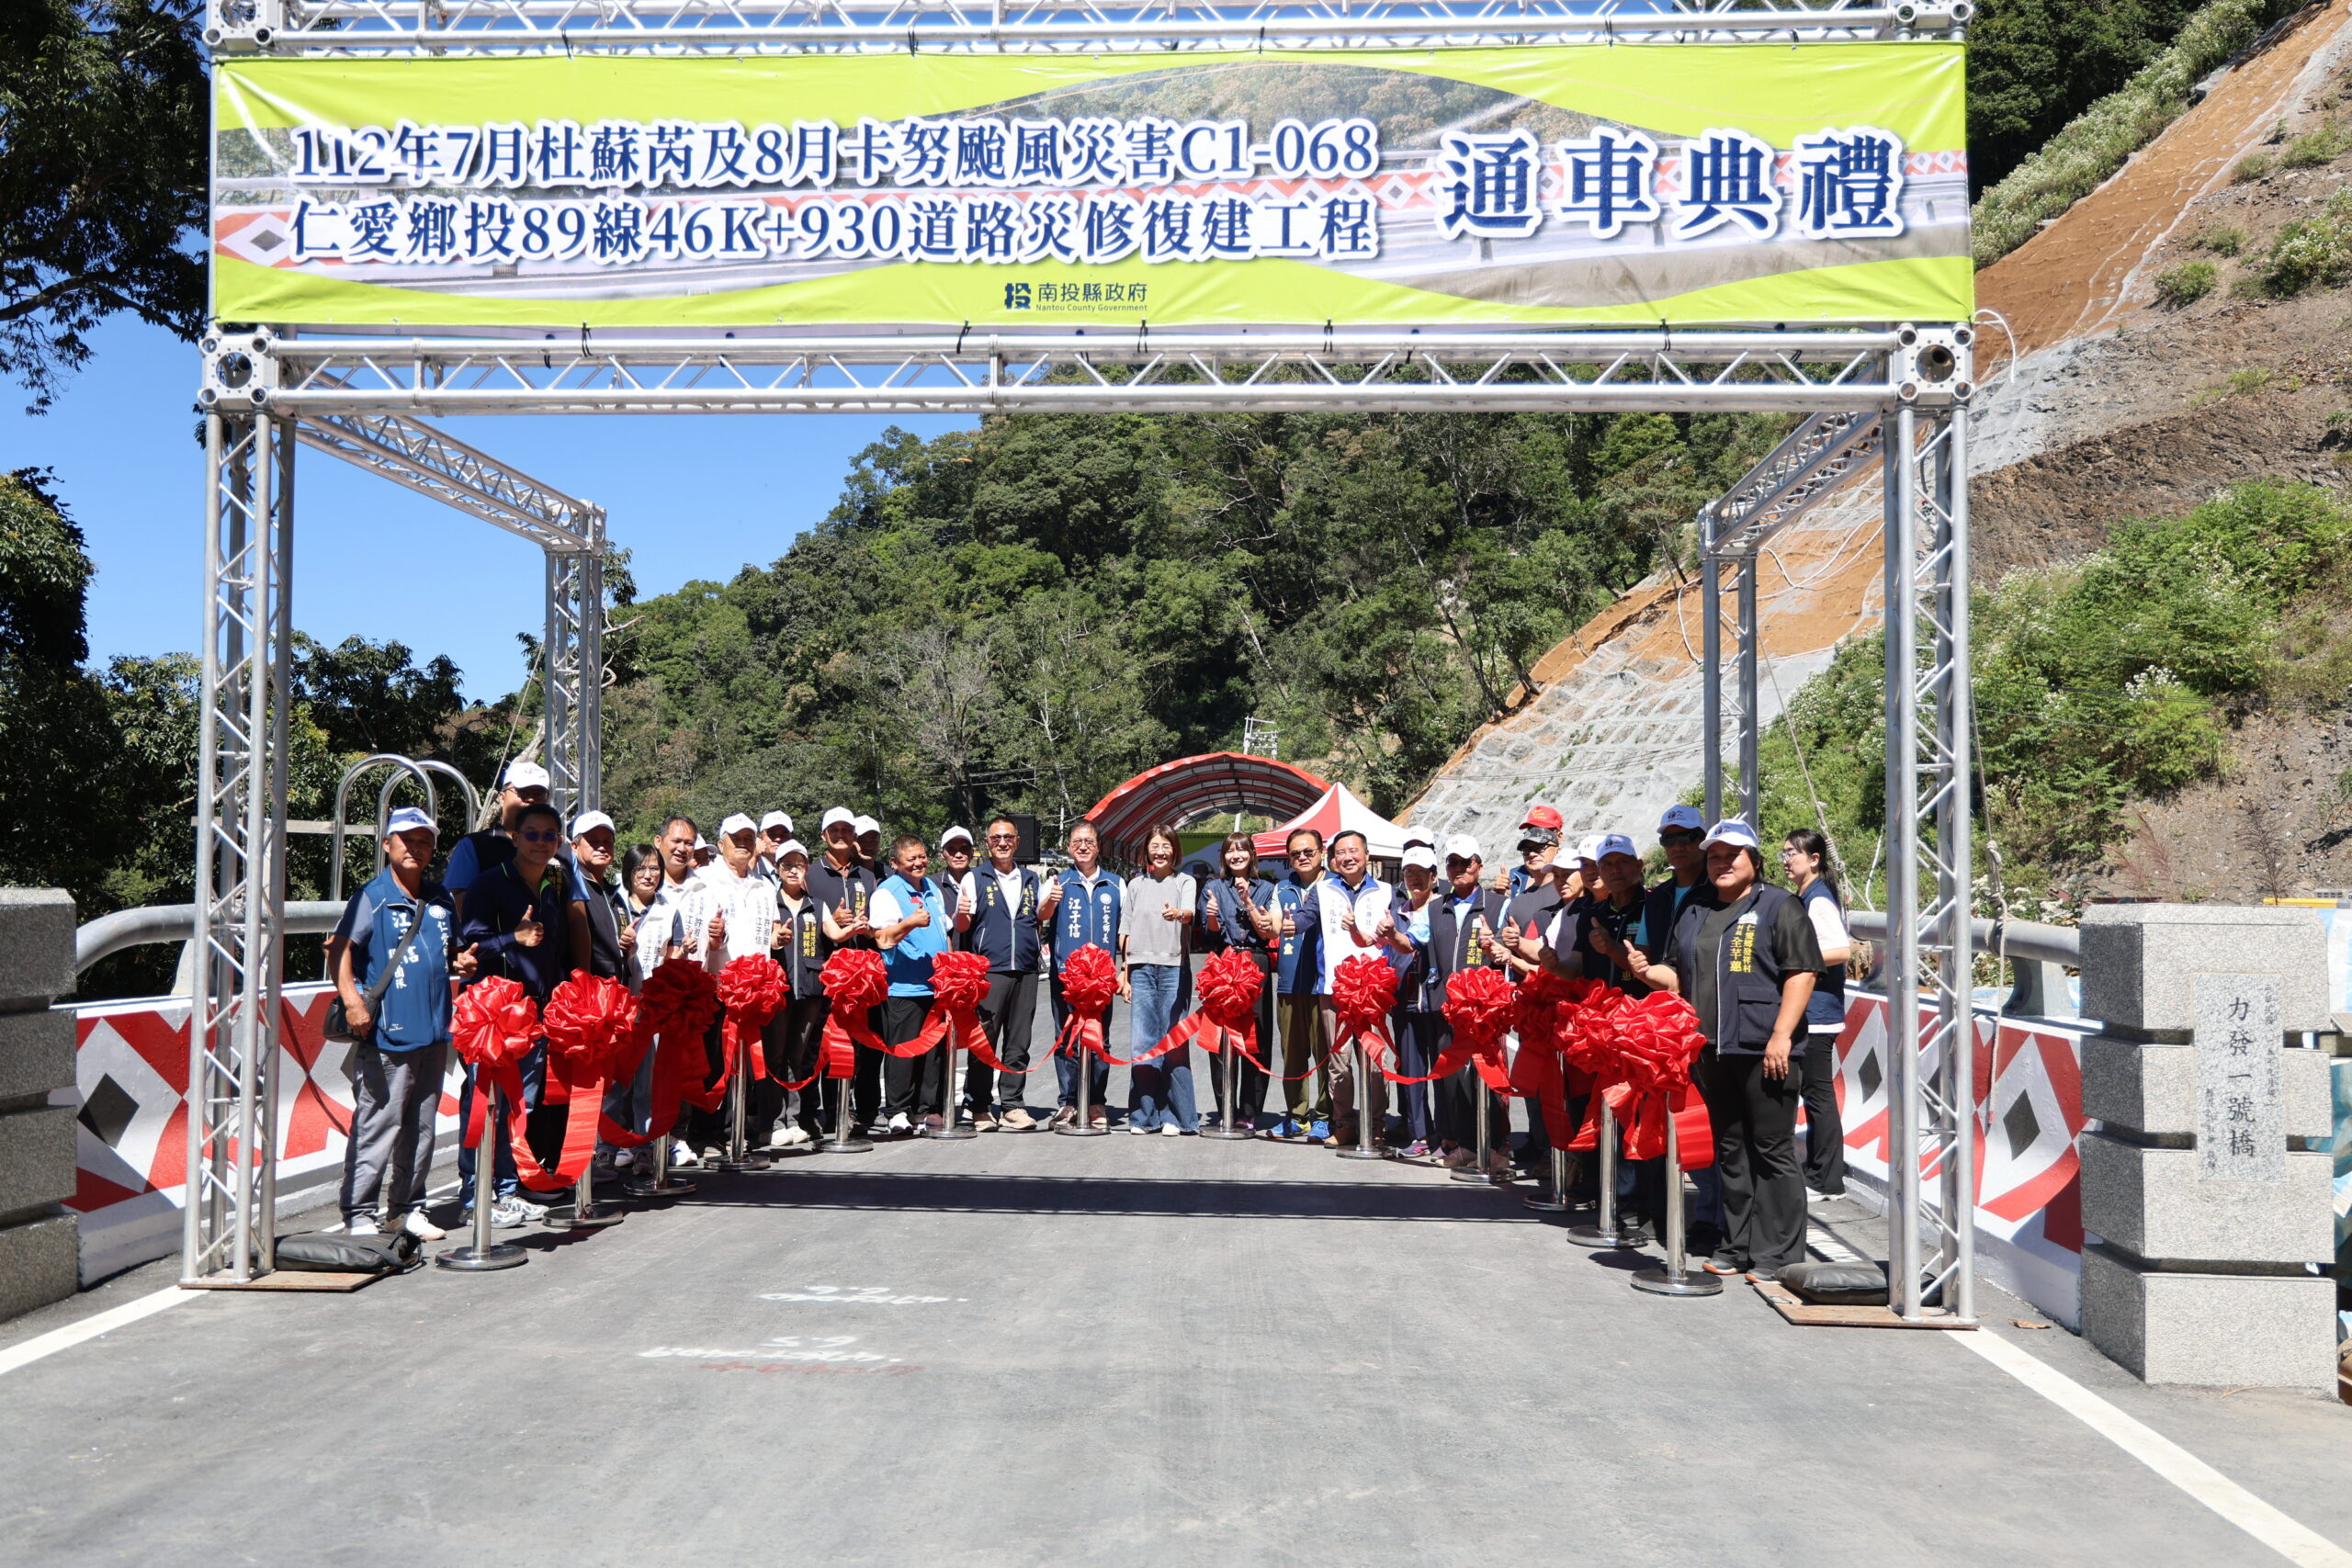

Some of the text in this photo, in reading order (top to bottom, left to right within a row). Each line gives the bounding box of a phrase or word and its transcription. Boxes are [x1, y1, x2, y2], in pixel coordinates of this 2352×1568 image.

[294, 121, 1376, 183] 112年7月杜蘇芮及8月卡努颱風災害C1-068
[1444, 134, 1896, 233] 通車典禮
[290, 197, 1375, 261] 仁愛鄉投89線46K+930道路災修復建工程
[1036, 304, 1148, 314] Nantou County Government
[1038, 282, 1148, 302] 南投縣政府
[1068, 897, 1082, 938] 江子信
[1102, 905, 1111, 943] 仁愛鄉長
[2227, 997, 2256, 1157] 力發一號橋
